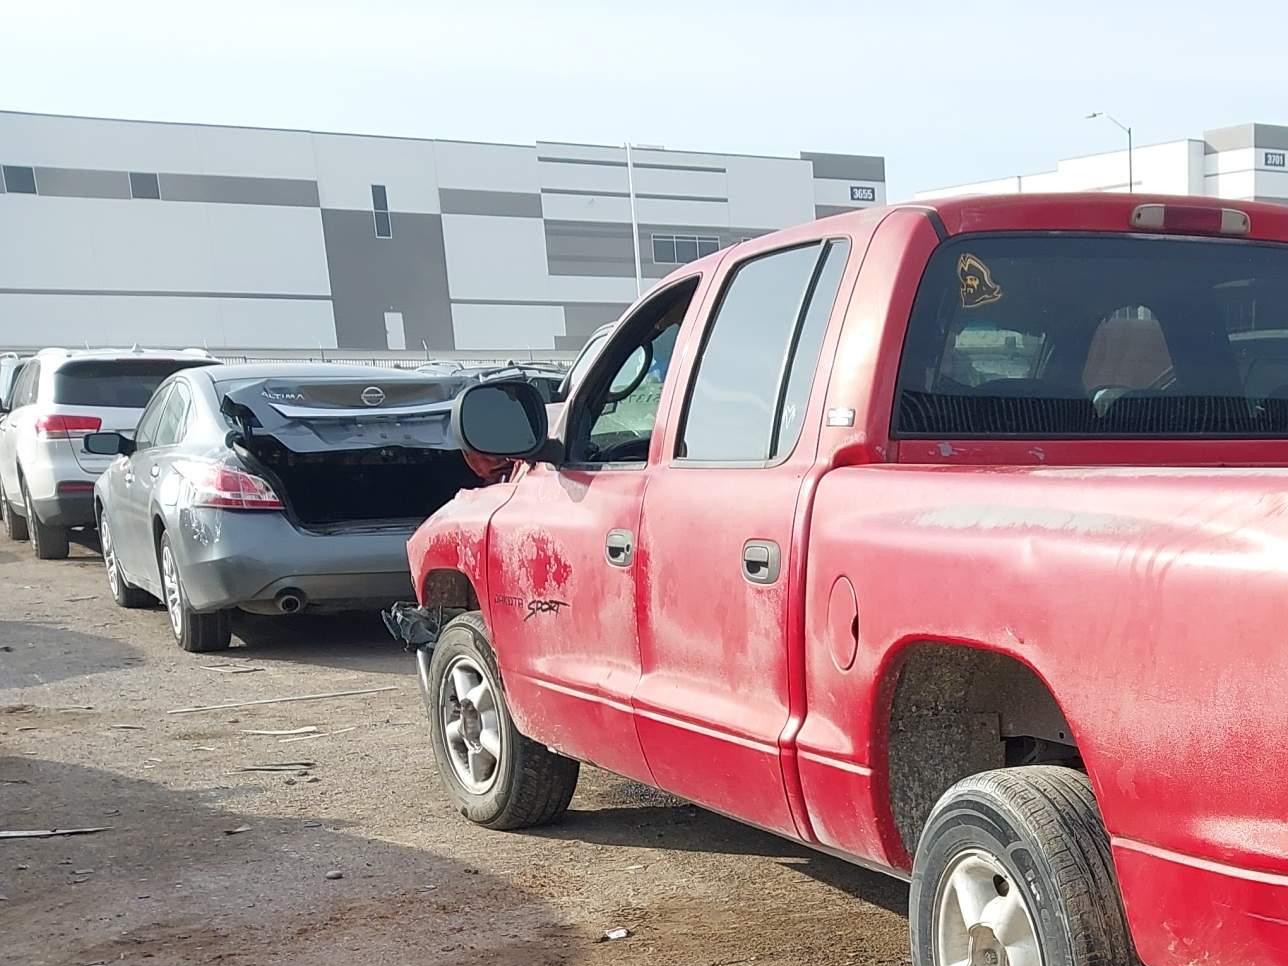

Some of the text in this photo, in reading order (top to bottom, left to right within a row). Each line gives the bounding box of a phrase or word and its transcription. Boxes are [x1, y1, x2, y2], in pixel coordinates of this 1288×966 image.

[852, 188, 874, 199] 3655
[261, 391, 305, 400] ALTIMA
[523, 599, 571, 622] SPORT
